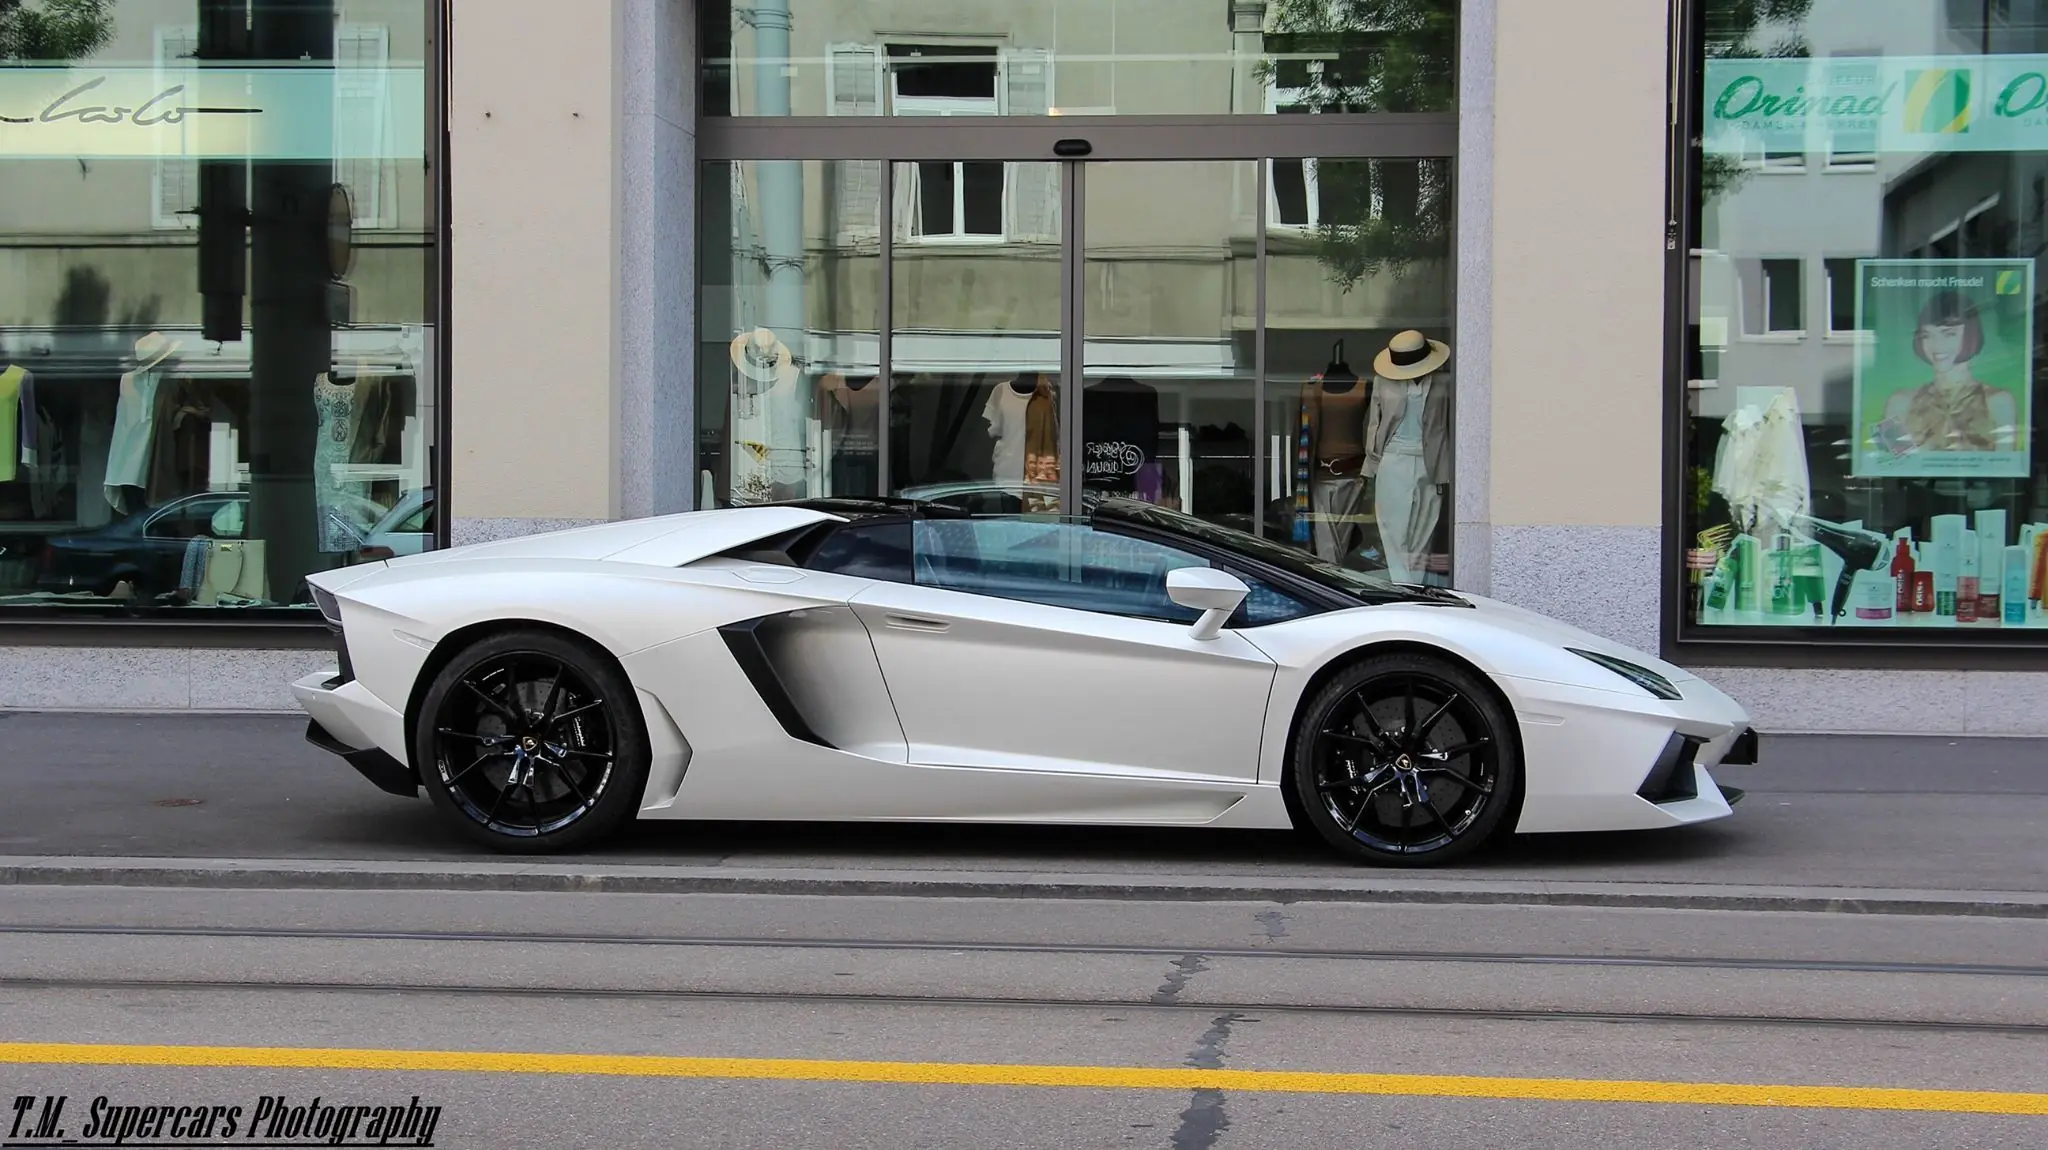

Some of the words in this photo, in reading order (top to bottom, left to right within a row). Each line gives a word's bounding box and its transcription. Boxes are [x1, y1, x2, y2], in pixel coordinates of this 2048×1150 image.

[1713, 75, 1898, 120] Orinad
[1993, 72, 2048, 118] O
[1871, 276, 1917, 288] Schenken
[1918, 276, 1948, 288] macht
[1949, 276, 1984, 288] Freude!
